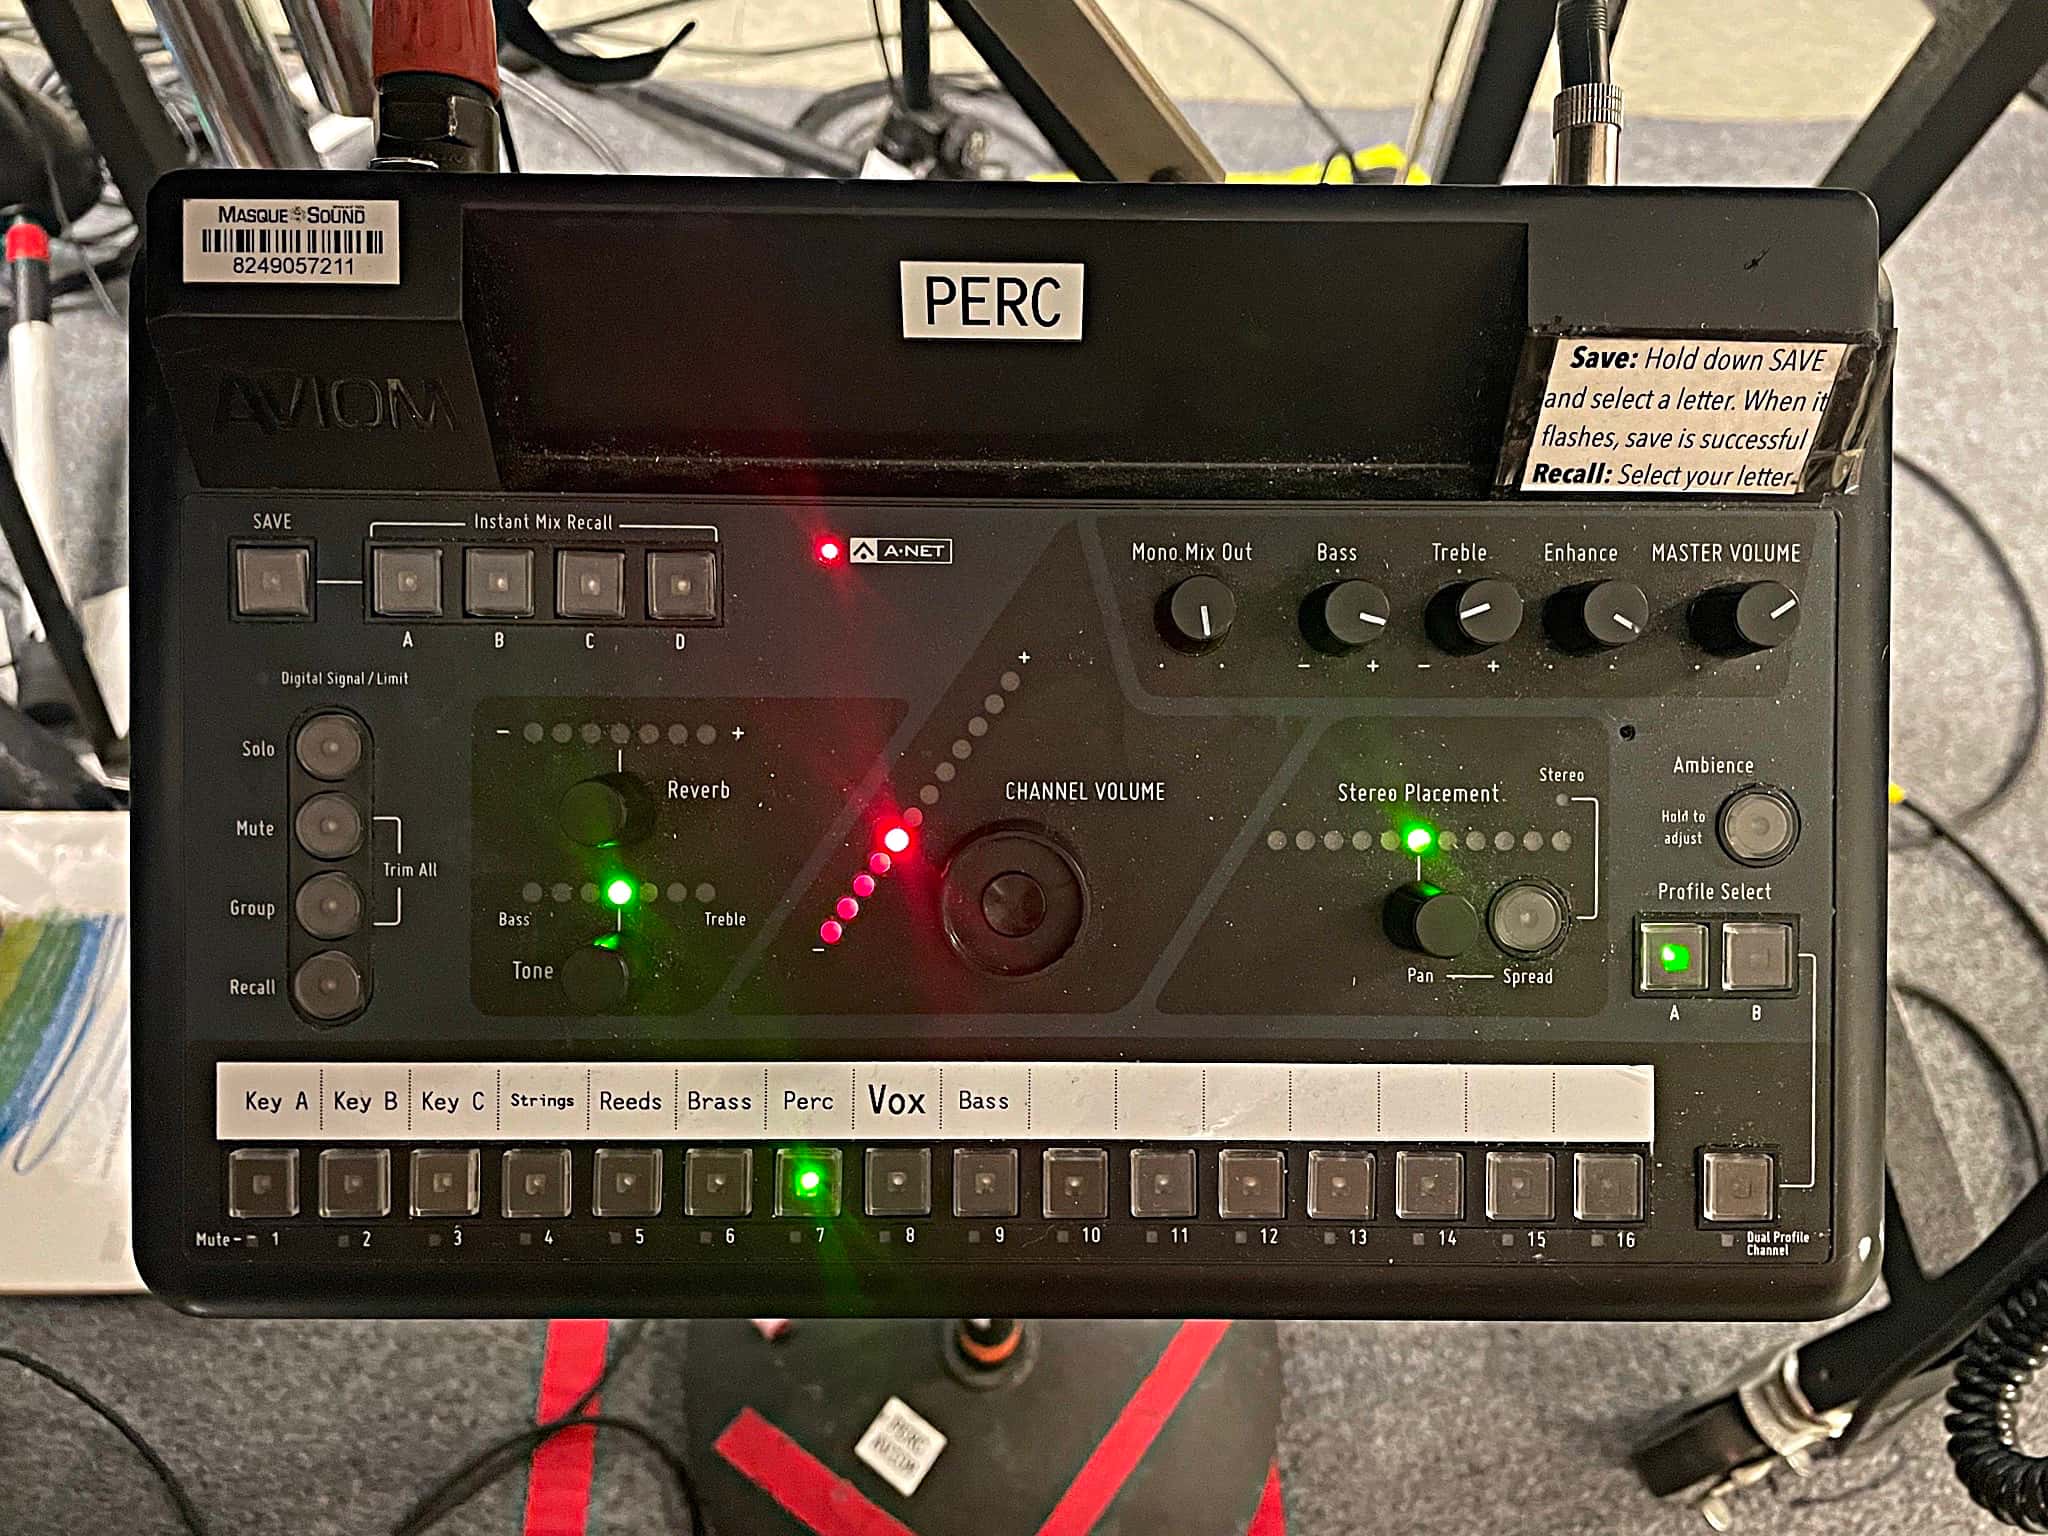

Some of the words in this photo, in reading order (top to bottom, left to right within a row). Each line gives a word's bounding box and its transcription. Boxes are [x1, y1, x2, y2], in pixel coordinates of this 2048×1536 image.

[218, 205, 289, 224] MASQUE
[307, 205, 366, 225] SOUND
[232, 256, 353, 275] 8249057211
[925, 275, 1061, 328] PERC
[1570, 345, 1638, 369] Save:
[1645, 346, 1700, 371] Hold
[1703, 347, 1763, 372] down
[1768, 348, 1828, 372] SAVE
[1544, 386, 1588, 409] and
[1590, 386, 1655, 410] select
[1658, 392, 1670, 410] a
[1676, 387, 1736, 411] letter.
[1744, 389, 1806, 412] When
[1812, 390, 1829, 412] it
[1541, 424, 1619, 450] flashes,
[1625, 432, 1672, 449] save
[1678, 428, 1695, 449] is
[1700, 427, 1809, 451] successful
[1532, 462, 1613, 484] Recall:
[1617, 463, 1681, 486] Select
[1682, 470, 1734, 491] your
[253, 513, 291, 530] SAVE
[474, 513, 529, 529] Instant
[535, 513, 561, 530] Mix
[567, 513, 613, 530] Recall
[1132, 542, 1178, 561] Mono
[1185, 542, 1215, 561] Mix
[1222, 541, 1253, 561] Out
[1317, 542, 1357, 562] Bass
[1431, 542, 1487, 562] Treble
[1544, 542, 1618, 562] Enhance
[1652, 543, 1723, 562] MASTER
[1729, 543, 1801, 563] VOLUME
[402, 630, 414, 648] A
[494, 631, 504, 648] B
[585, 632, 595, 649] C
[675, 633, 685, 650] D
[281, 671, 322, 688] Digital
[242, 740, 275, 757] Solo
[1673, 755, 1754, 774] Ambience
[1539, 767, 1585, 782] Stereo
[668, 780, 730, 799] Reverb
[1006, 781, 1089, 801] CHANNEL
[1094, 781, 1165, 801] VOLUME
[1338, 782, 1397, 802] Stereo
[1405, 783, 1500, 803] Placement
[1661, 808, 1689, 823] Hold
[1693, 809, 1706, 823] to
[236, 820, 274, 836] Mute
[1664, 831, 1702, 848] adjust
[383, 862, 413, 877] Trim
[418, 862, 437, 877] All
[1658, 881, 1714, 900] Profile
[1721, 882, 1772, 900] Select
[230, 899, 275, 920] Group
[499, 911, 530, 927] Bass
[704, 911, 746, 926] Treble
[512, 960, 554, 980] Tone
[1407, 967, 1434, 983] Pan
[1503, 967, 1553, 988] Spread
[230, 978, 276, 995] Recall
[1669, 1004, 1680, 1021] A
[1752, 1004, 1762, 1021] B
[246, 1090, 282, 1114] Key
[295, 1090, 309, 1111] A
[334, 1090, 372, 1114] Key
[384, 1090, 398, 1111] B
[422, 1090, 460, 1114] Key
[472, 1091, 485, 1111] C
[510, 1092, 575, 1111] Strings
[600, 1090, 662, 1111] Reeds
[688, 1090, 752, 1111] Brass
[784, 1090, 834, 1110] Perc
[868, 1083, 926, 1115] Vox
[959, 1090, 1009, 1110] Bass
[271, 1231, 279, 1246] 1
[362, 1230, 371, 1247] 2
[453, 1229, 462, 1246] 3
[544, 1229, 554, 1245] 4
[635, 1228, 644, 1245] 5
[725, 1227, 735, 1244] 6
[815, 1227, 825, 1243] 7
[906, 1226, 915, 1243] 8
[995, 1226, 1004, 1243] 9
[1082, 1226, 1101, 1243] 10
[1171, 1227, 1188, 1243] 11
[1260, 1227, 1278, 1244] 12
[1349, 1228, 1367, 1245] 13
[1438, 1229, 1457, 1246] 14
[1527, 1230, 1546, 1248] 15
[1617, 1230, 1636, 1248] 16
[1747, 1230, 1771, 1244] Dual
[1773, 1230, 1810, 1244] Profile
[1746, 1243, 1789, 1256] Channel
